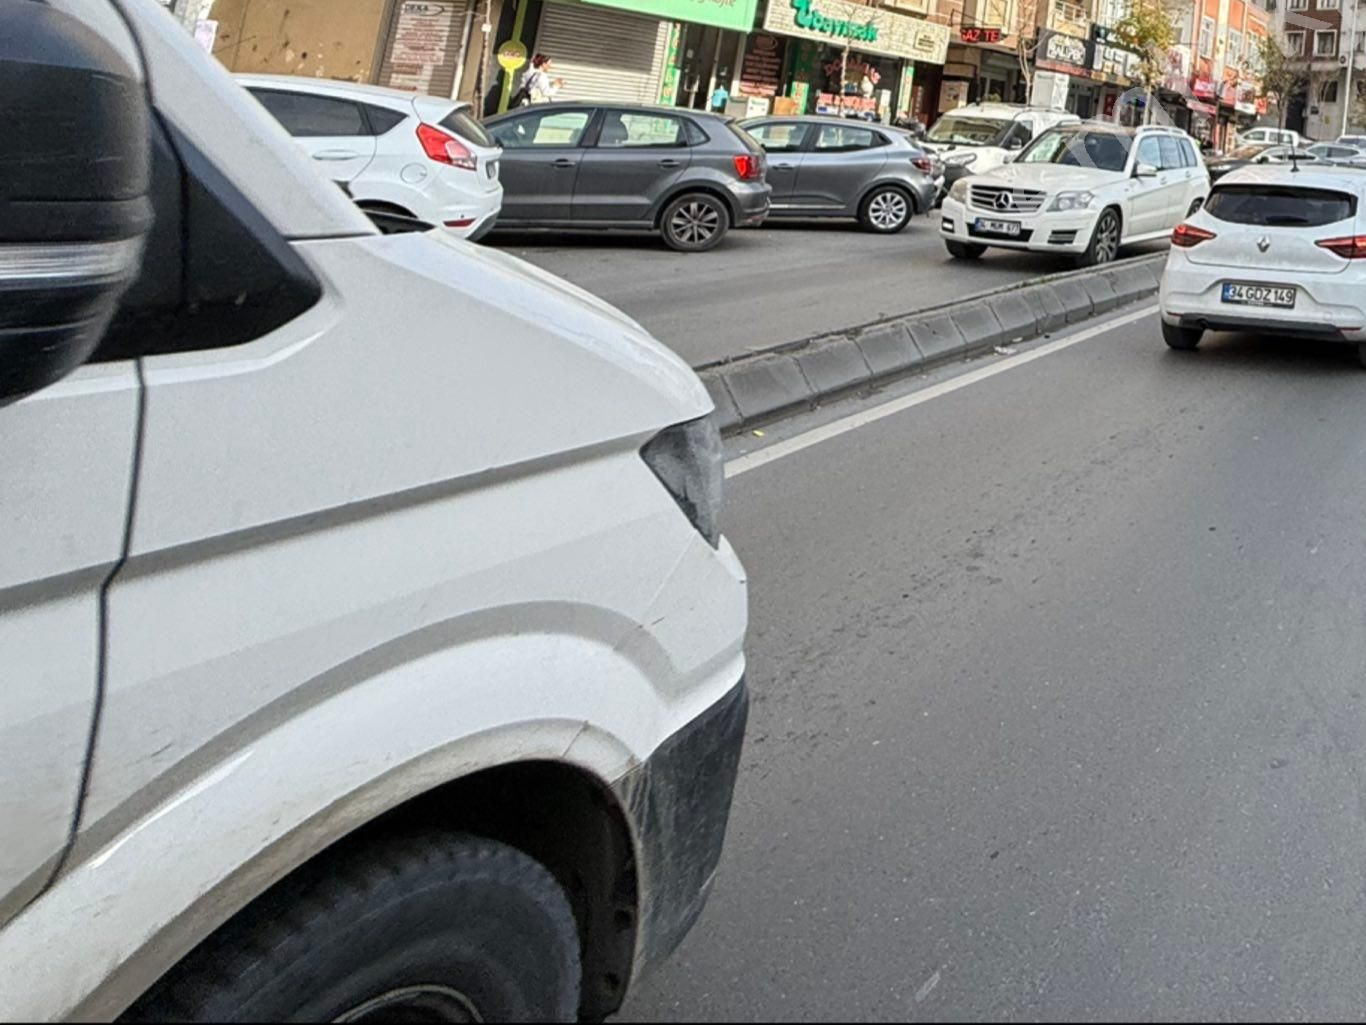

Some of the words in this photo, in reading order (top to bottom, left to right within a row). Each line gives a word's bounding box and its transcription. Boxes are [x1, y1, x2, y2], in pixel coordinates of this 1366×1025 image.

[1230, 286, 1244, 298] 34
[1246, 287, 1272, 301] GDZ
[1274, 288, 1294, 303] 149
